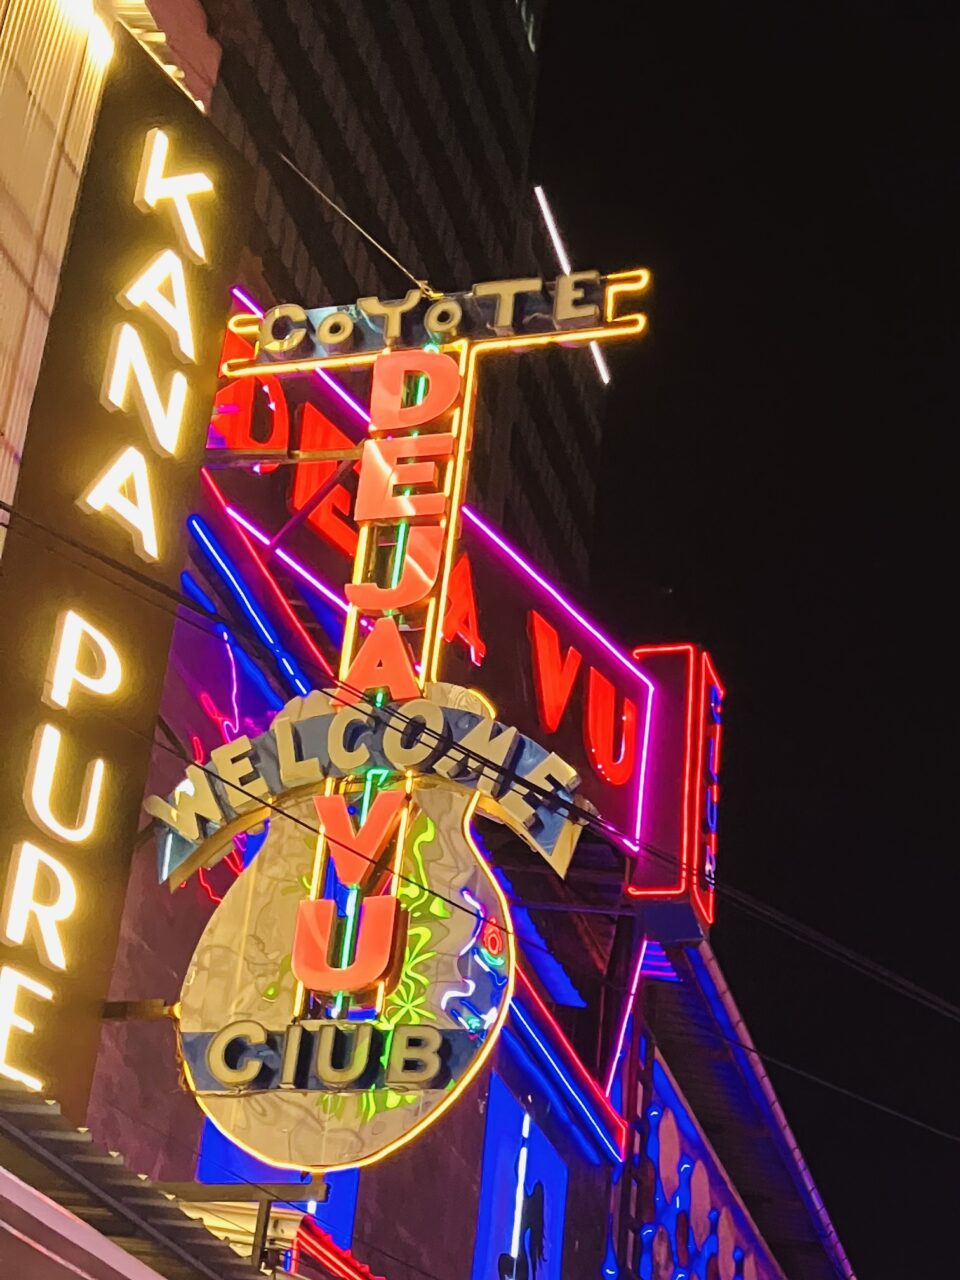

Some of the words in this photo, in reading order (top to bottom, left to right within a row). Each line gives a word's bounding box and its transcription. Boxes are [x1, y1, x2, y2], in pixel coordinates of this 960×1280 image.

[78, 127, 214, 563] KANA
[330, 350, 461, 706] DEJA
[0, 610, 123, 1092] PURE
[145, 702, 580, 842] WELCOME
[291, 790, 408, 992] VU
